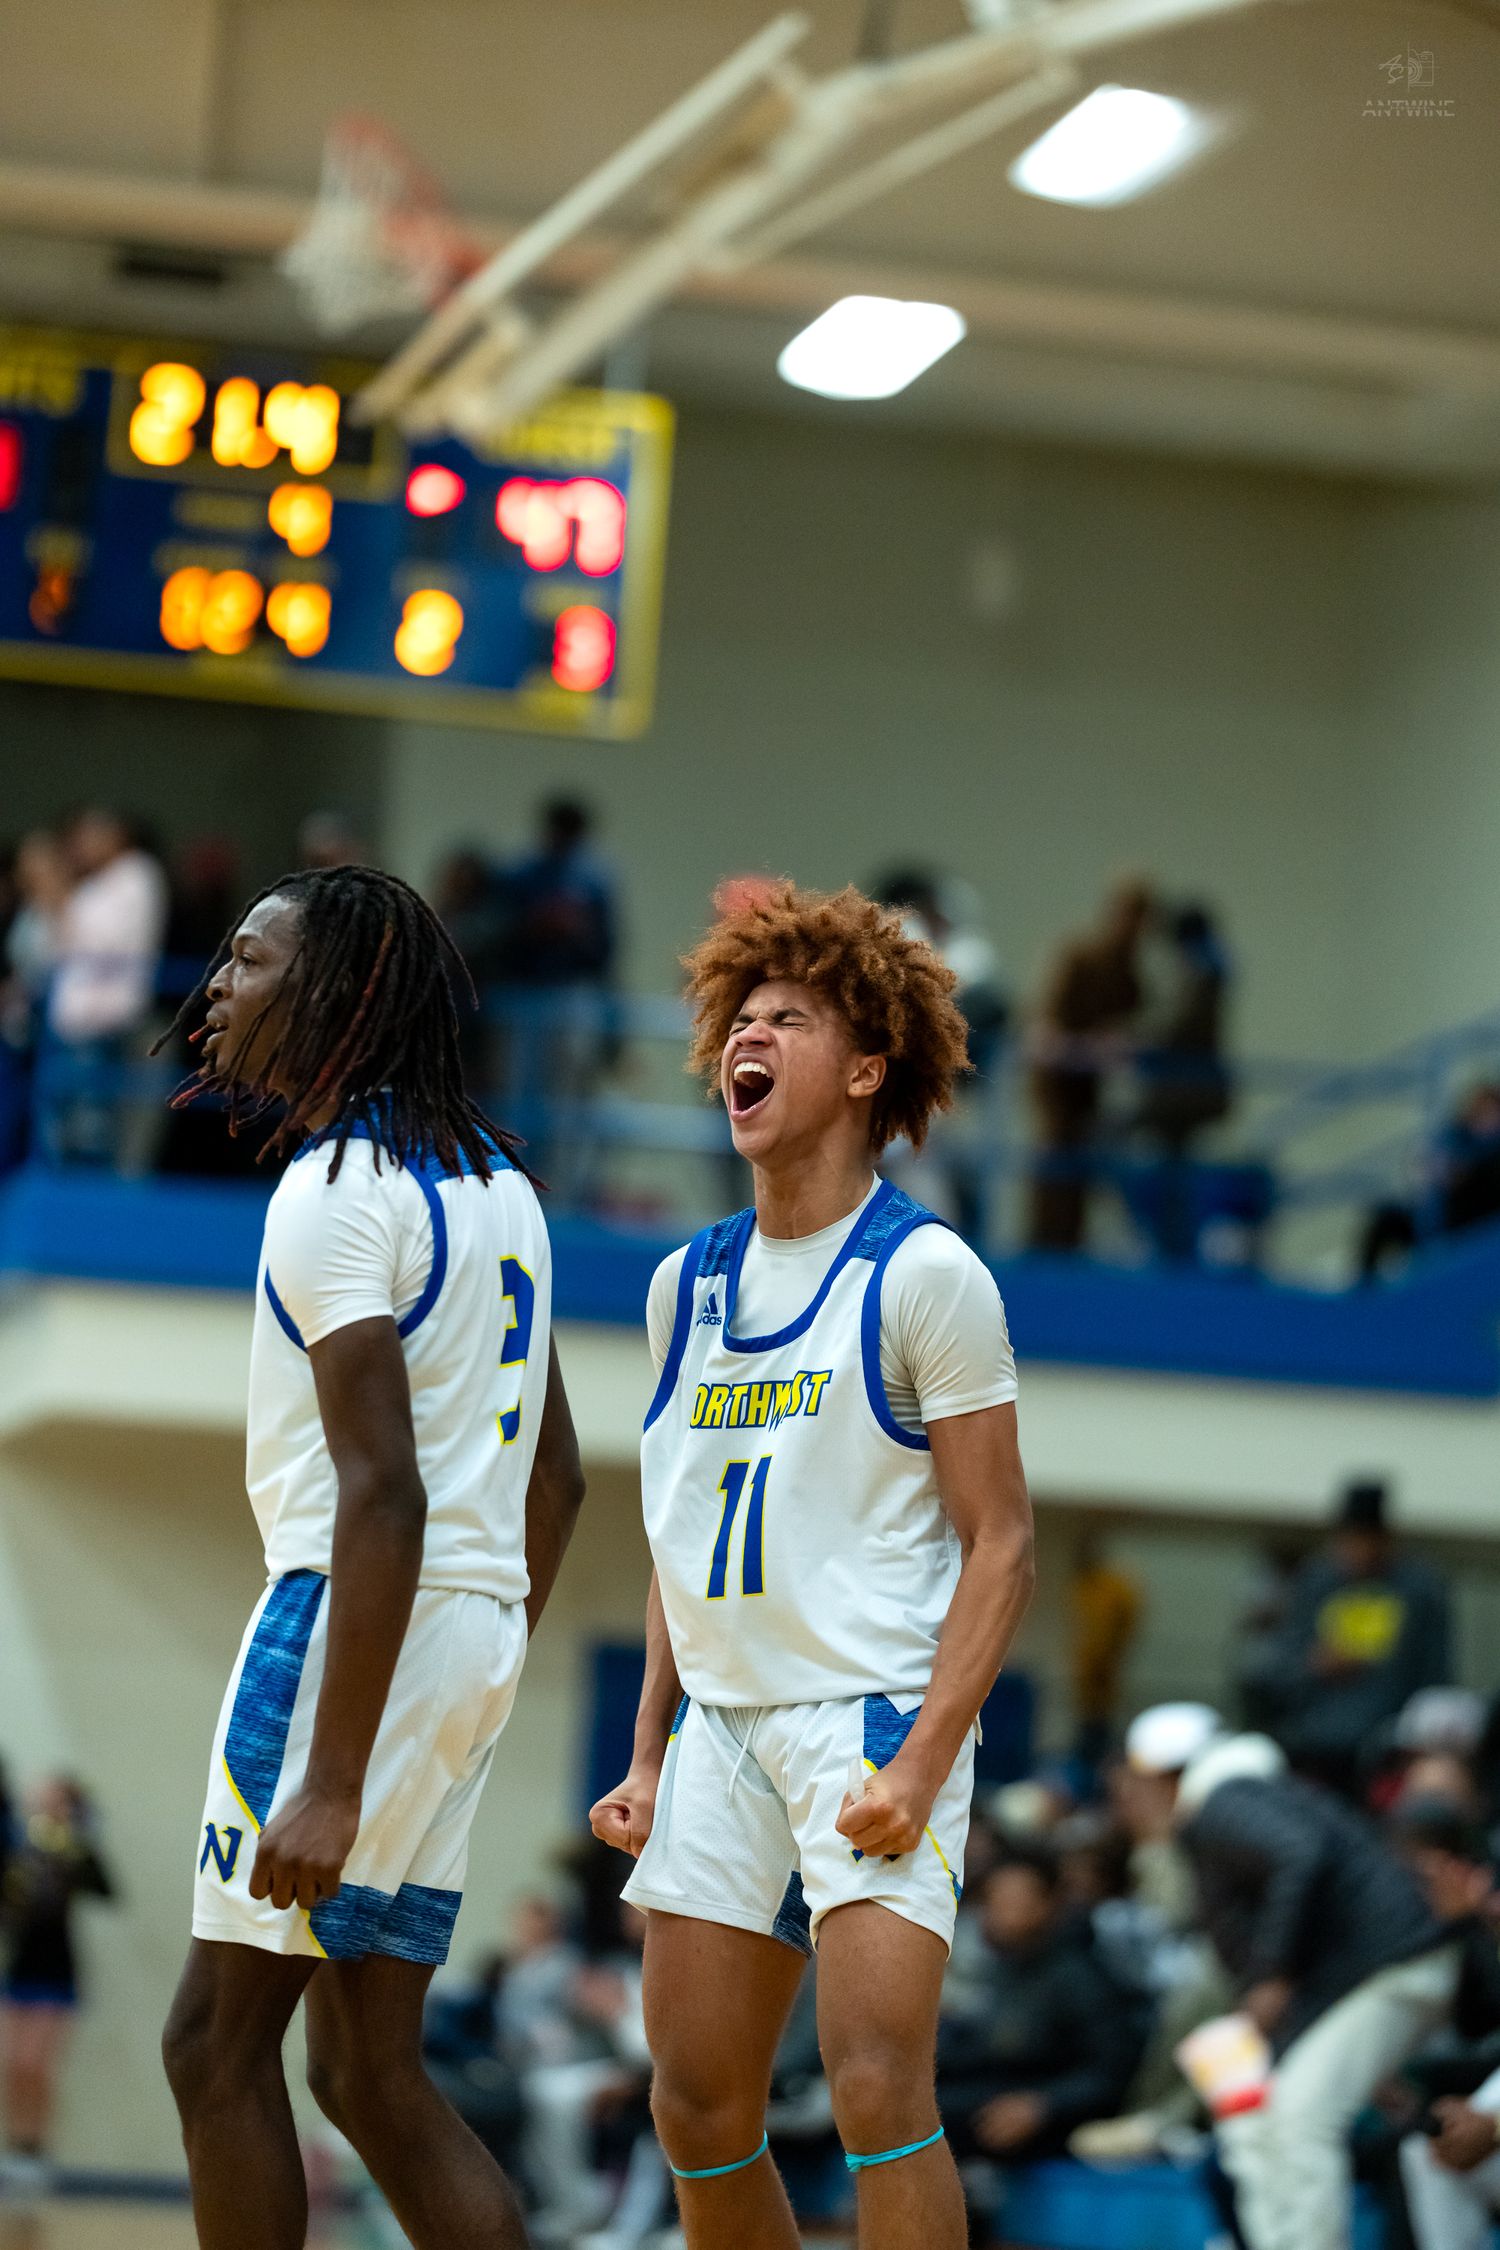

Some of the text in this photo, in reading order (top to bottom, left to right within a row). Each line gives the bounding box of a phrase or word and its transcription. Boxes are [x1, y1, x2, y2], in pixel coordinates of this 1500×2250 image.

[690, 1369, 834, 1432] ORTHWST
[705, 1453, 774, 1600] 11
[199, 1821, 245, 1885] N
